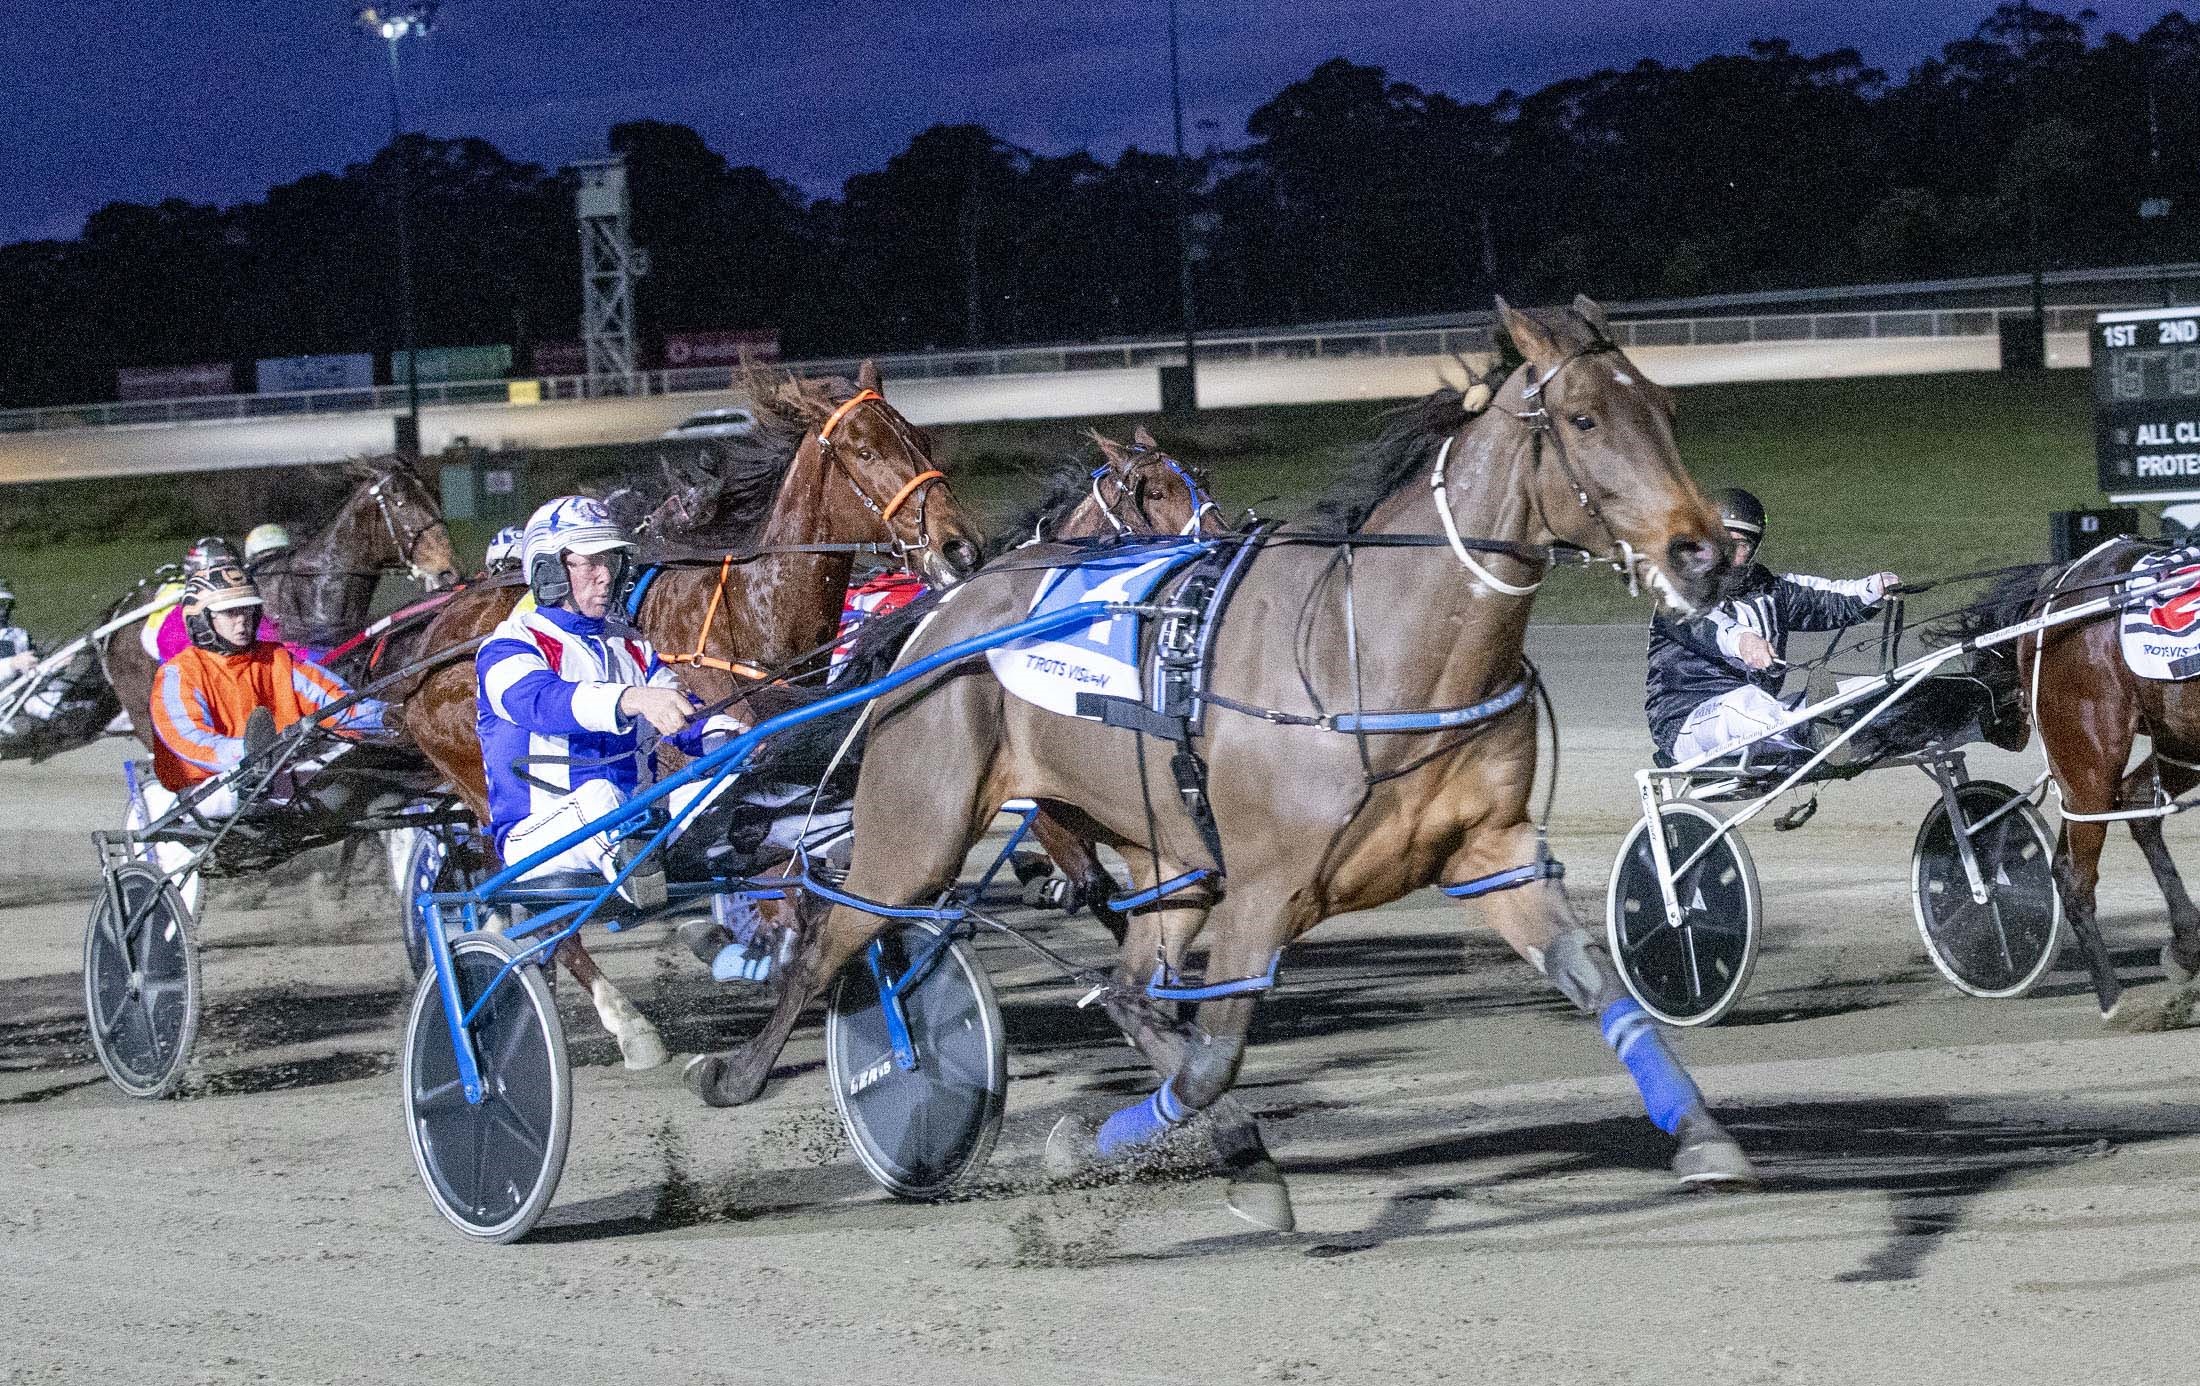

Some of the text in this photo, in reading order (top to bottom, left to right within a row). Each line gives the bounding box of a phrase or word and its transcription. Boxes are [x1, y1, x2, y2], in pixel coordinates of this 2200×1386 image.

[2103, 320, 2199, 347] 1ST 2ND
[2136, 421, 2200, 446] ALL CL
[2136, 453, 2200, 477] PROTE
[1026, 654, 1067, 677] TROTS
